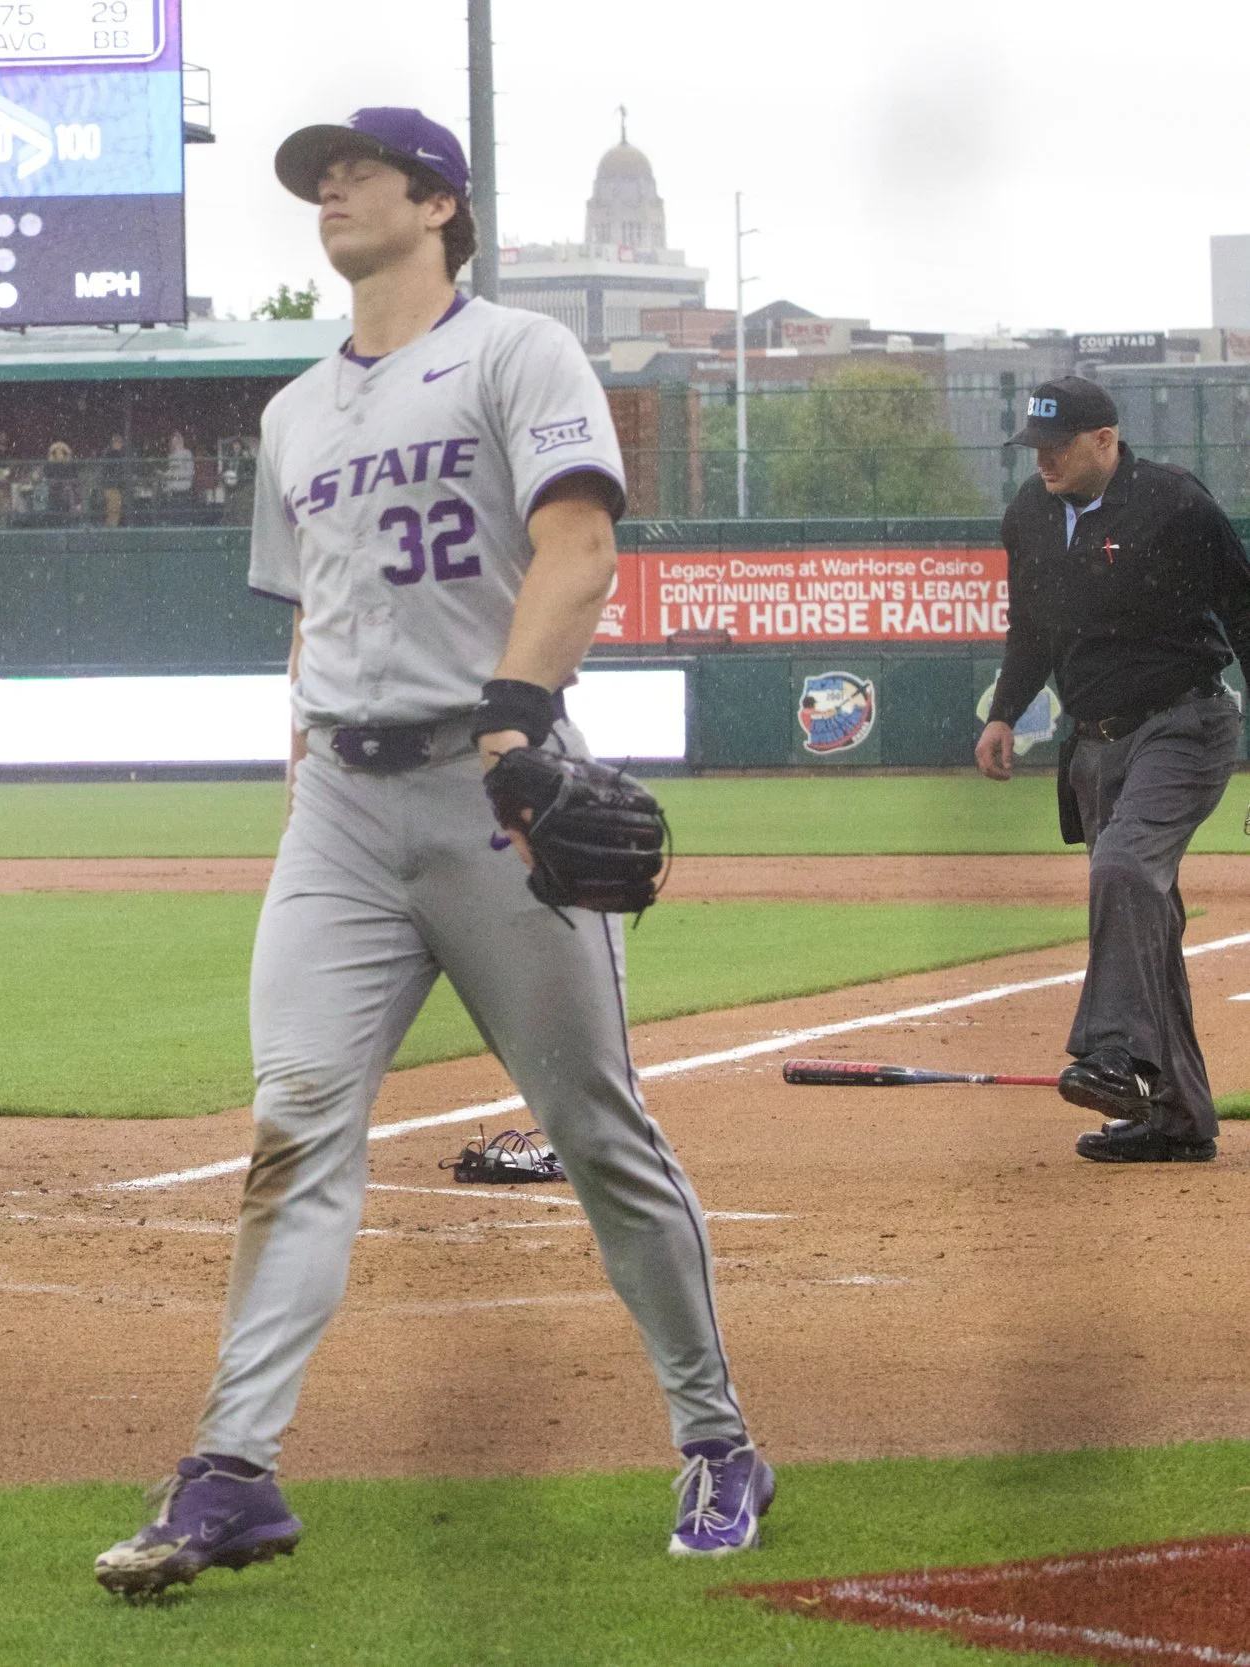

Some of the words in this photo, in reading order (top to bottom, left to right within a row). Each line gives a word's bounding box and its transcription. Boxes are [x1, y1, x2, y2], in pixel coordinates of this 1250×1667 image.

[92, 1, 128, 24] 29
[93, 30, 129, 49] BB
[55, 124, 101, 161] 100
[75, 271, 140, 298] MPH
[1079, 335, 1156, 348] COURTYARD
[378, 497, 482, 587] 32
[659, 560, 726, 583] Legacy
[730, 559, 795, 578] Downs
[799, 560, 818, 577] at
[821, 558, 916, 577] WarHorse
[660, 583, 790, 603] CONTINUING
[795, 581, 906, 602] LINCOLN'S
[910, 580, 991, 600] LEGACY
[660, 603, 739, 636] LIVE
[750, 602, 869, 636] HORSE
[880, 601, 1011, 634] RACING
